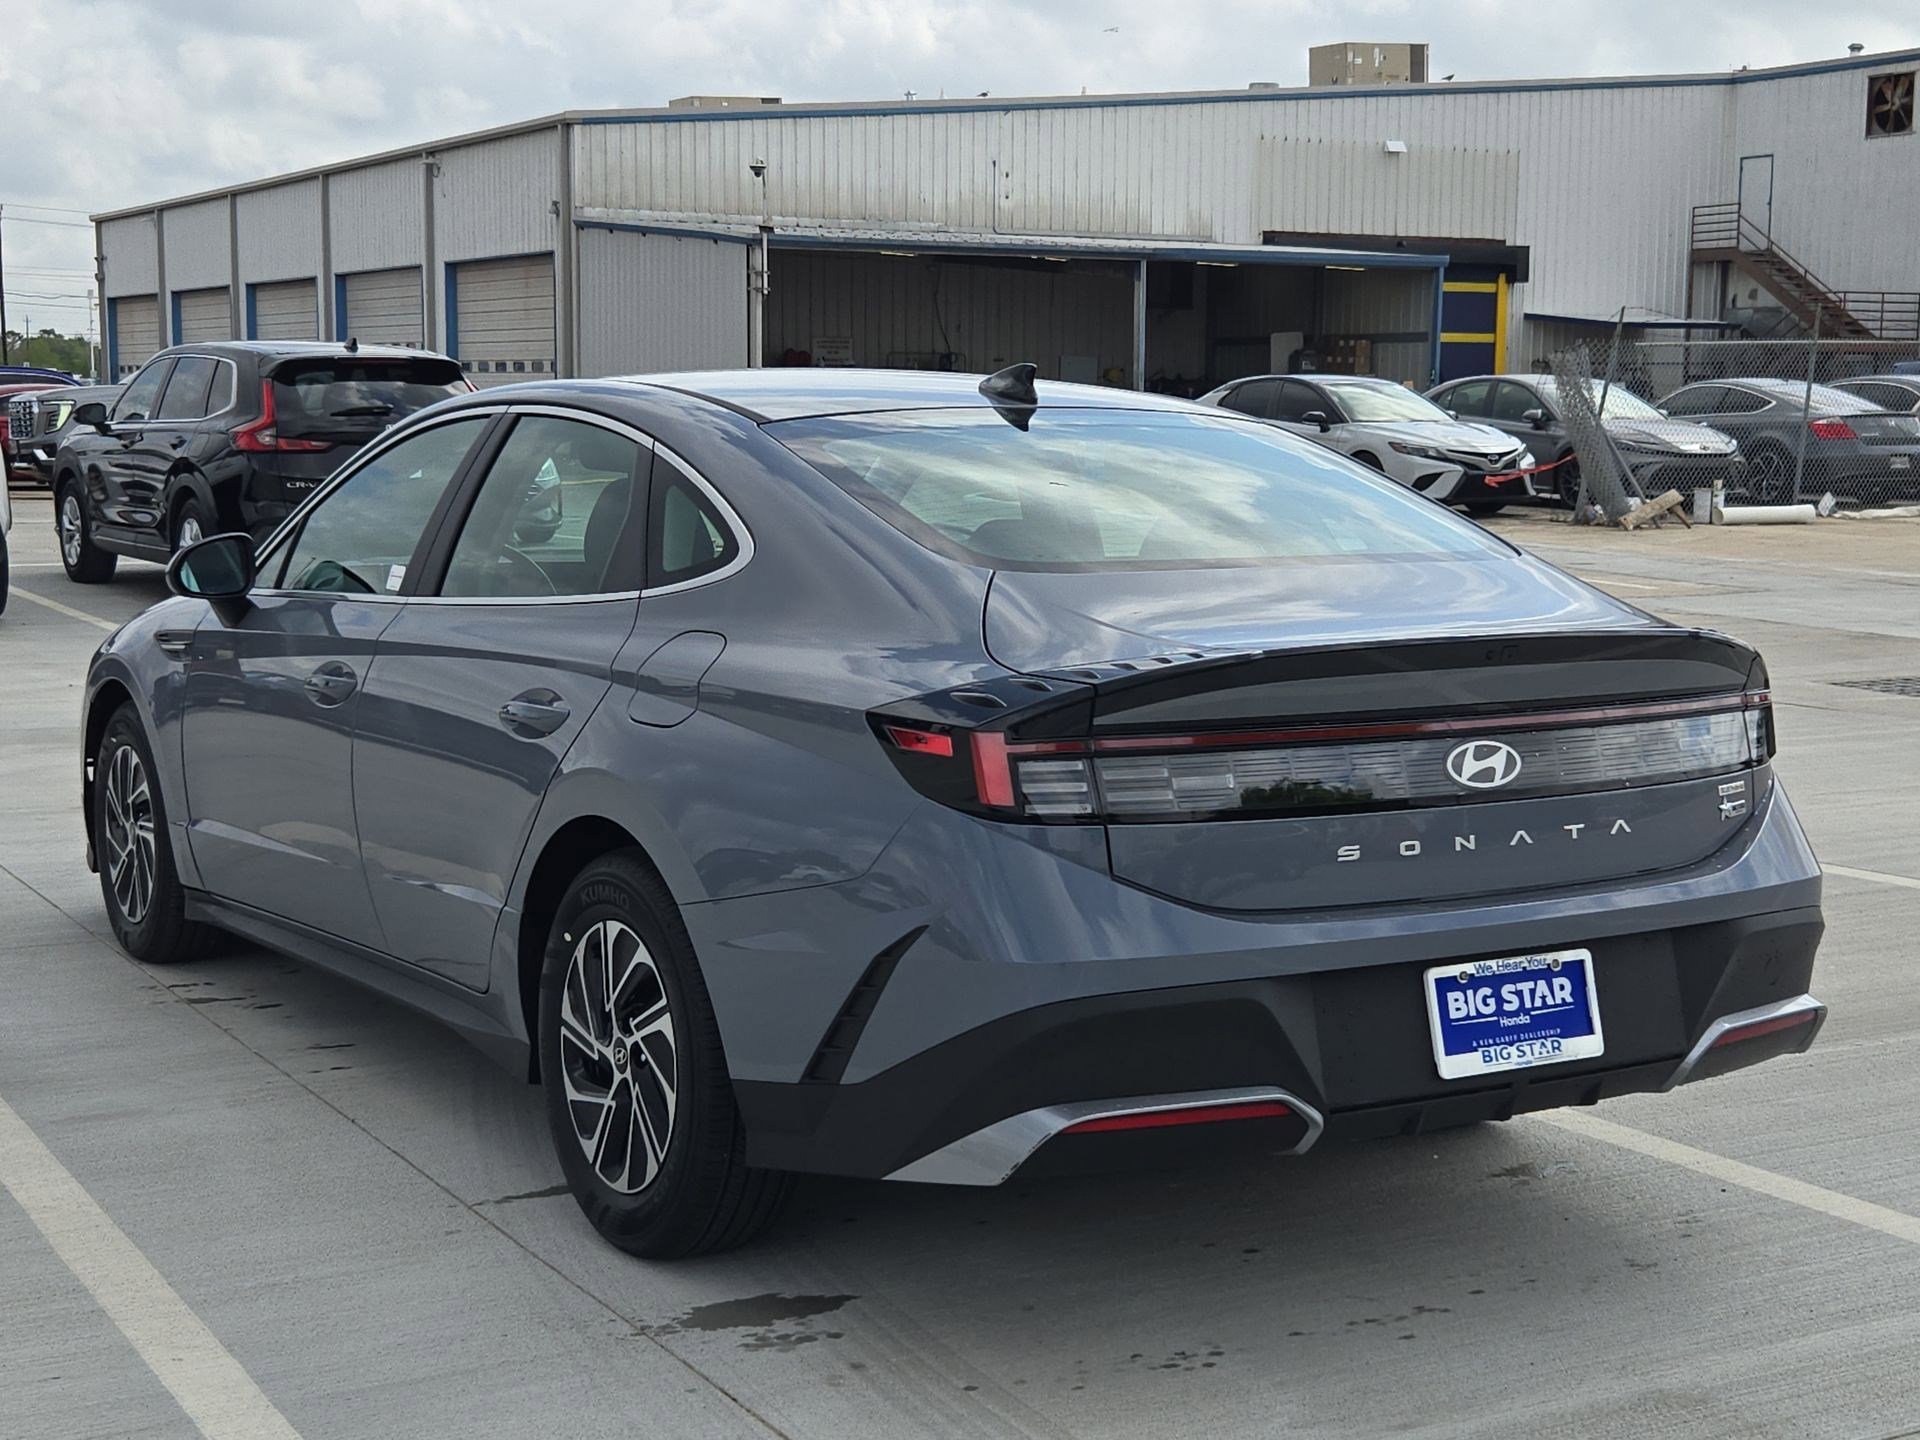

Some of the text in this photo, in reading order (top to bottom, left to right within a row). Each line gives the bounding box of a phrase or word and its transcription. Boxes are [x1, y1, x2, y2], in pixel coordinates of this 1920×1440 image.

[1337, 819, 1632, 862] SONATA
[581, 884, 630, 910] KUMHO
[1473, 962, 1493, 974] We
[1496, 960, 1525, 972] Hear
[1446, 977, 1574, 1019] BIG STAR
[1500, 1012, 1530, 1027] Honda
[1479, 1038, 1494, 1046] KEN
[1520, 1028, 1561, 1040] DEALERSHIP
[1481, 1039, 1562, 1063] BIG STAR
